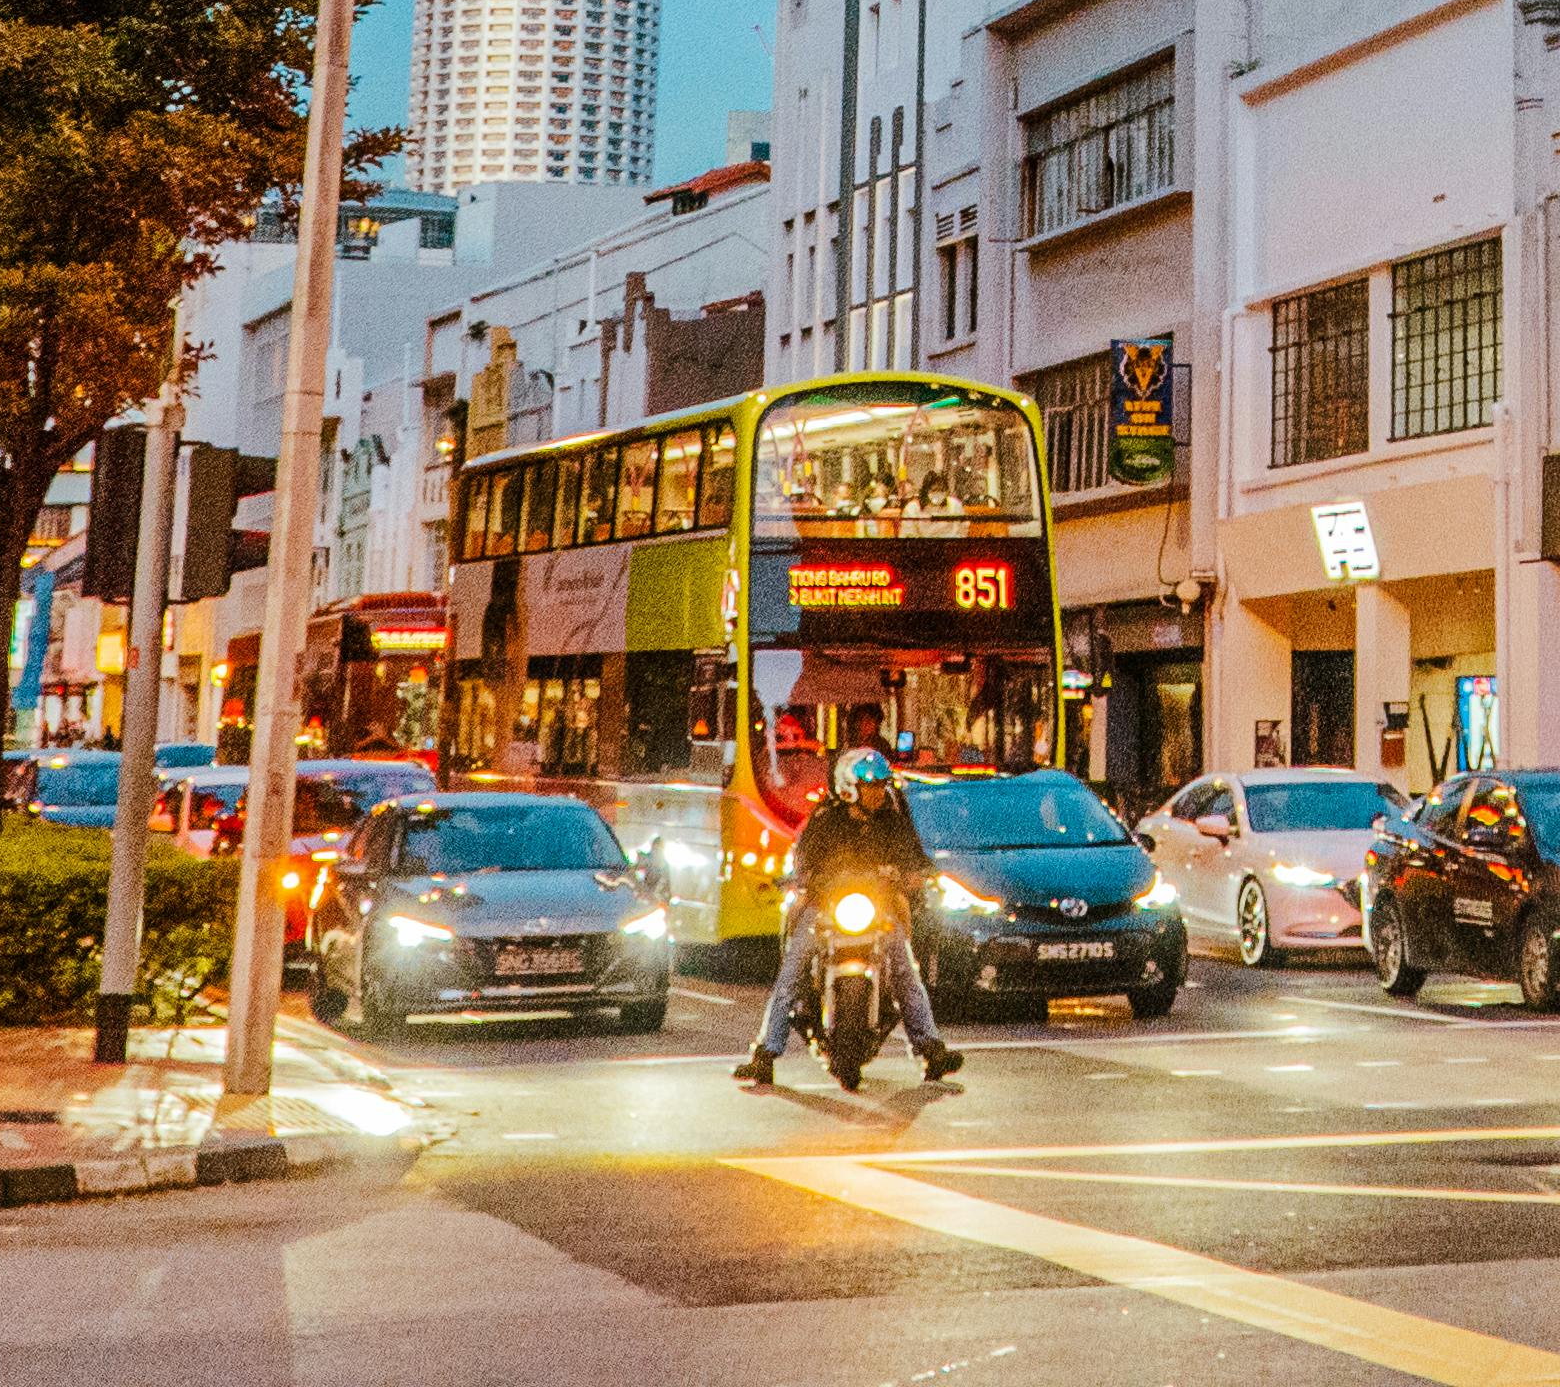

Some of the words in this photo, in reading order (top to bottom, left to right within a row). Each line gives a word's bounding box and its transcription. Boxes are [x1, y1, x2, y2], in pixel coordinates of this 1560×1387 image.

[790, 568, 827, 587] TIONG
[828, 568, 871, 587] BAHRU
[800, 587, 837, 606] BUKIT
[838, 587, 881, 606] MERAH
[955, 566, 1009, 609] 851
